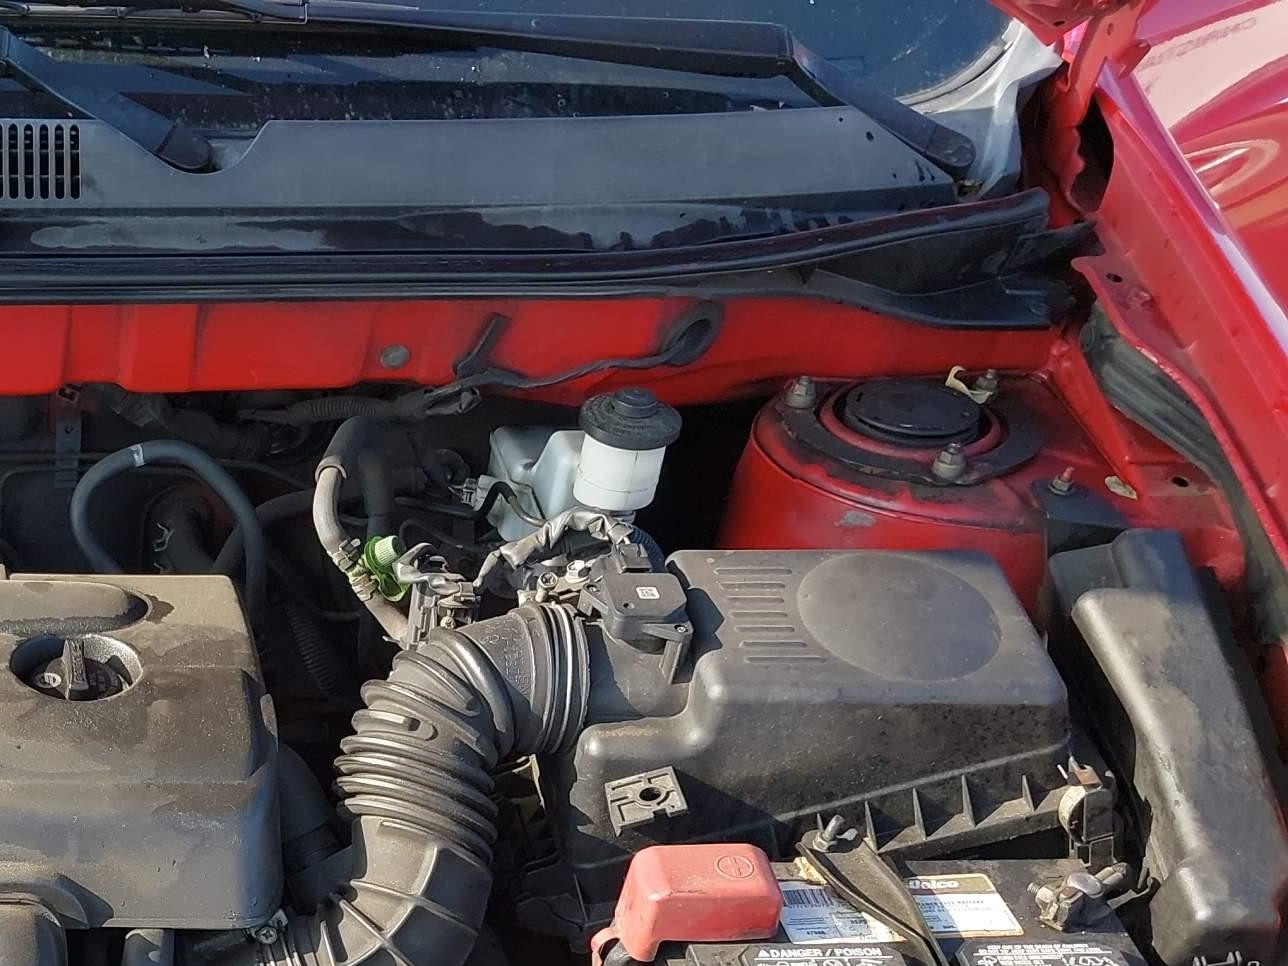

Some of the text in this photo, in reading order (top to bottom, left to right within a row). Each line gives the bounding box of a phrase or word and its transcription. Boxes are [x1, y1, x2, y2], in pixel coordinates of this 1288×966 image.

[909, 880, 959, 889] Delco
[771, 949, 822, 958] DANGER
[833, 948, 882, 957] POISON
